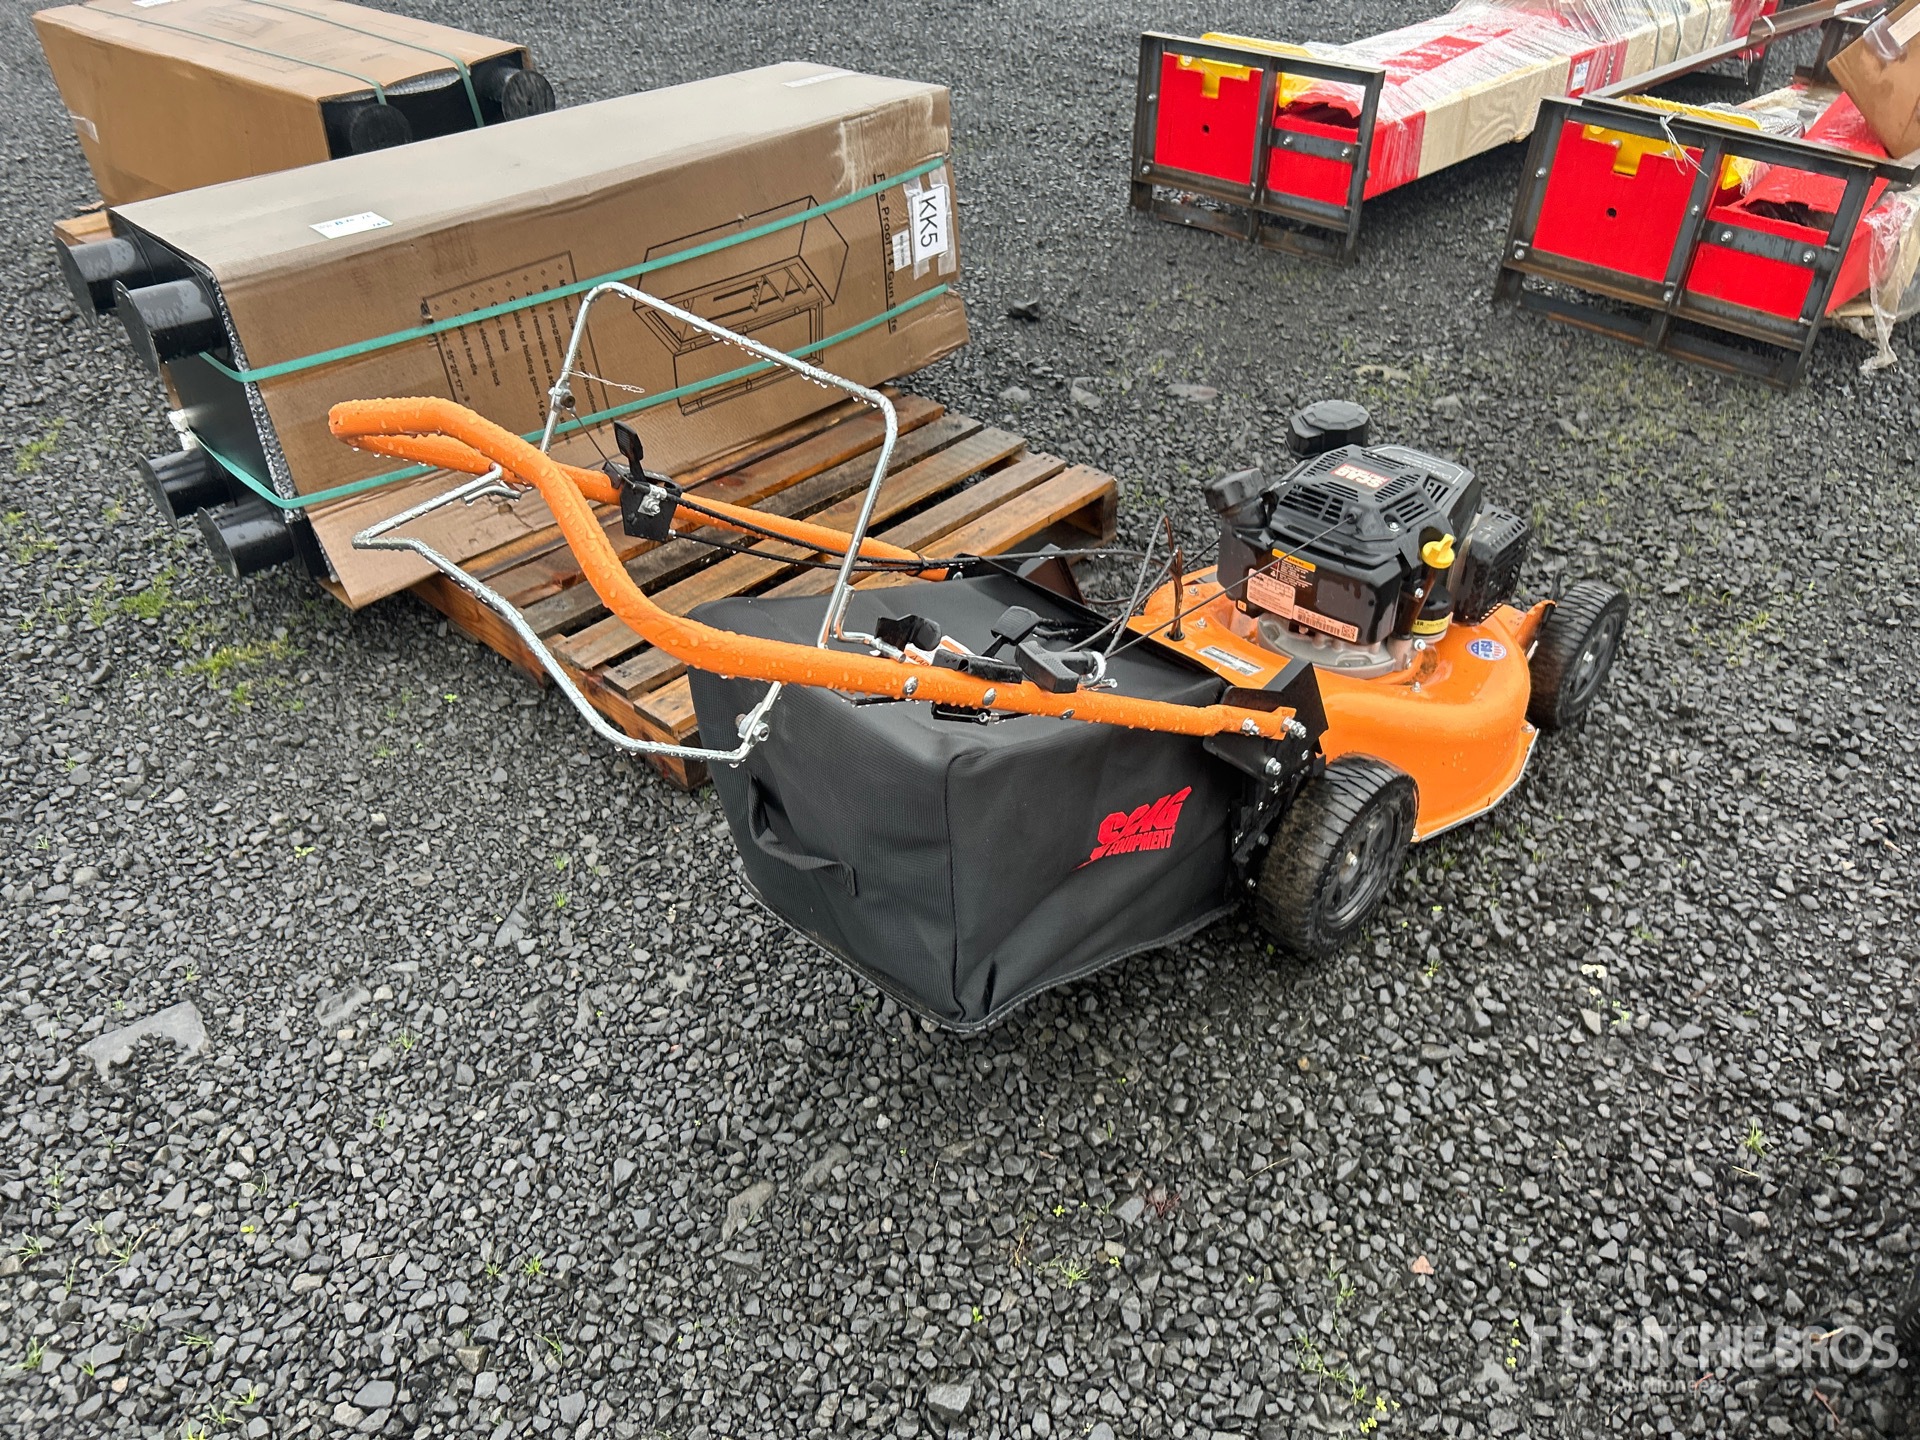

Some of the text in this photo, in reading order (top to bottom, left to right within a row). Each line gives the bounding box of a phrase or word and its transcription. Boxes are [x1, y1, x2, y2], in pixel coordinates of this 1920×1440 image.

[881, 206, 893, 246] Proof
[919, 195, 938, 247] KK5
[887, 270, 895, 299] Gun
[888, 302, 897, 333] Sfe
[498, 328, 511, 353] Black
[518, 330, 527, 343] for
[532, 314, 549, 357] removable
[543, 358, 553, 374] and
[465, 347, 479, 376] handle
[478, 327, 496, 369] electronic
[491, 369, 502, 387] lock
[520, 343, 536, 376] holding
[1105, 829, 1176, 857] EQUIPMENT
